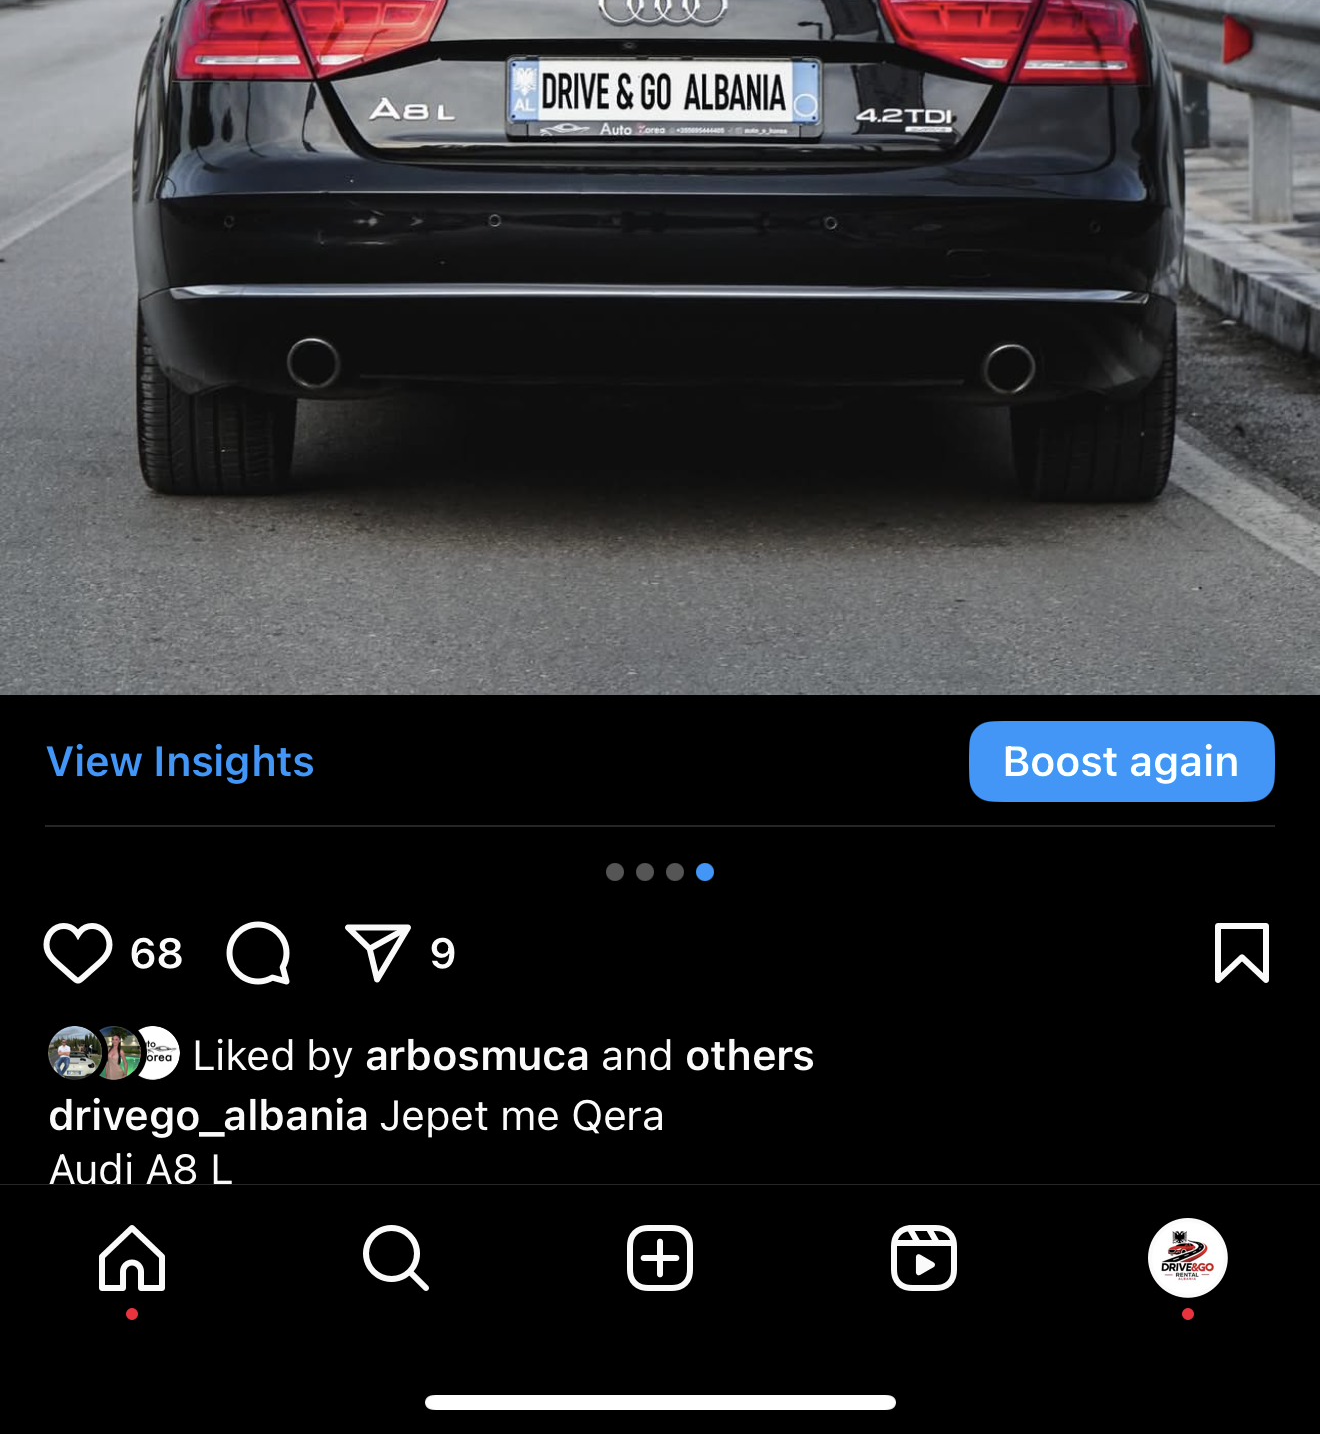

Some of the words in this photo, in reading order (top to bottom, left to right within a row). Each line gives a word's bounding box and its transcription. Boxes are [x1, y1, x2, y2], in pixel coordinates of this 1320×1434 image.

[513, 99, 536, 113] AL
[542, 72, 610, 110] DRIVE
[616, 72, 634, 110] &
[641, 72, 671, 110] GO
[684, 73, 786, 111] ALBANIA
[368, 96, 430, 121] A8
[436, 103, 456, 121] L
[600, 122, 633, 136] Auto
[46, 743, 143, 778] View
[156, 743, 314, 785] Insights
[1005, 745, 1117, 777] Boost
[1130, 743, 1238, 785] again
[130, 937, 183, 970] 68
[431, 937, 456, 970] 9
[195, 1038, 293, 1071] Liked
[308, 1038, 353, 1079] by
[366, 1038, 588, 1072] arbosmuca
[602, 1038, 671, 1071] and
[686, 1038, 814, 1072] others
[49, 1097, 367, 1139] drivego_albania
[380, 1099, 488, 1139] Jepet
[502, 1106, 559, 1131] me
[573, 1099, 663, 1134] Qera
[49, 1152, 133, 1184] Audi
[146, 1153, 197, 1184] A8
[213, 1153, 233, 1184] L
[1161, 1263, 1215, 1272] DRIVE&GO
